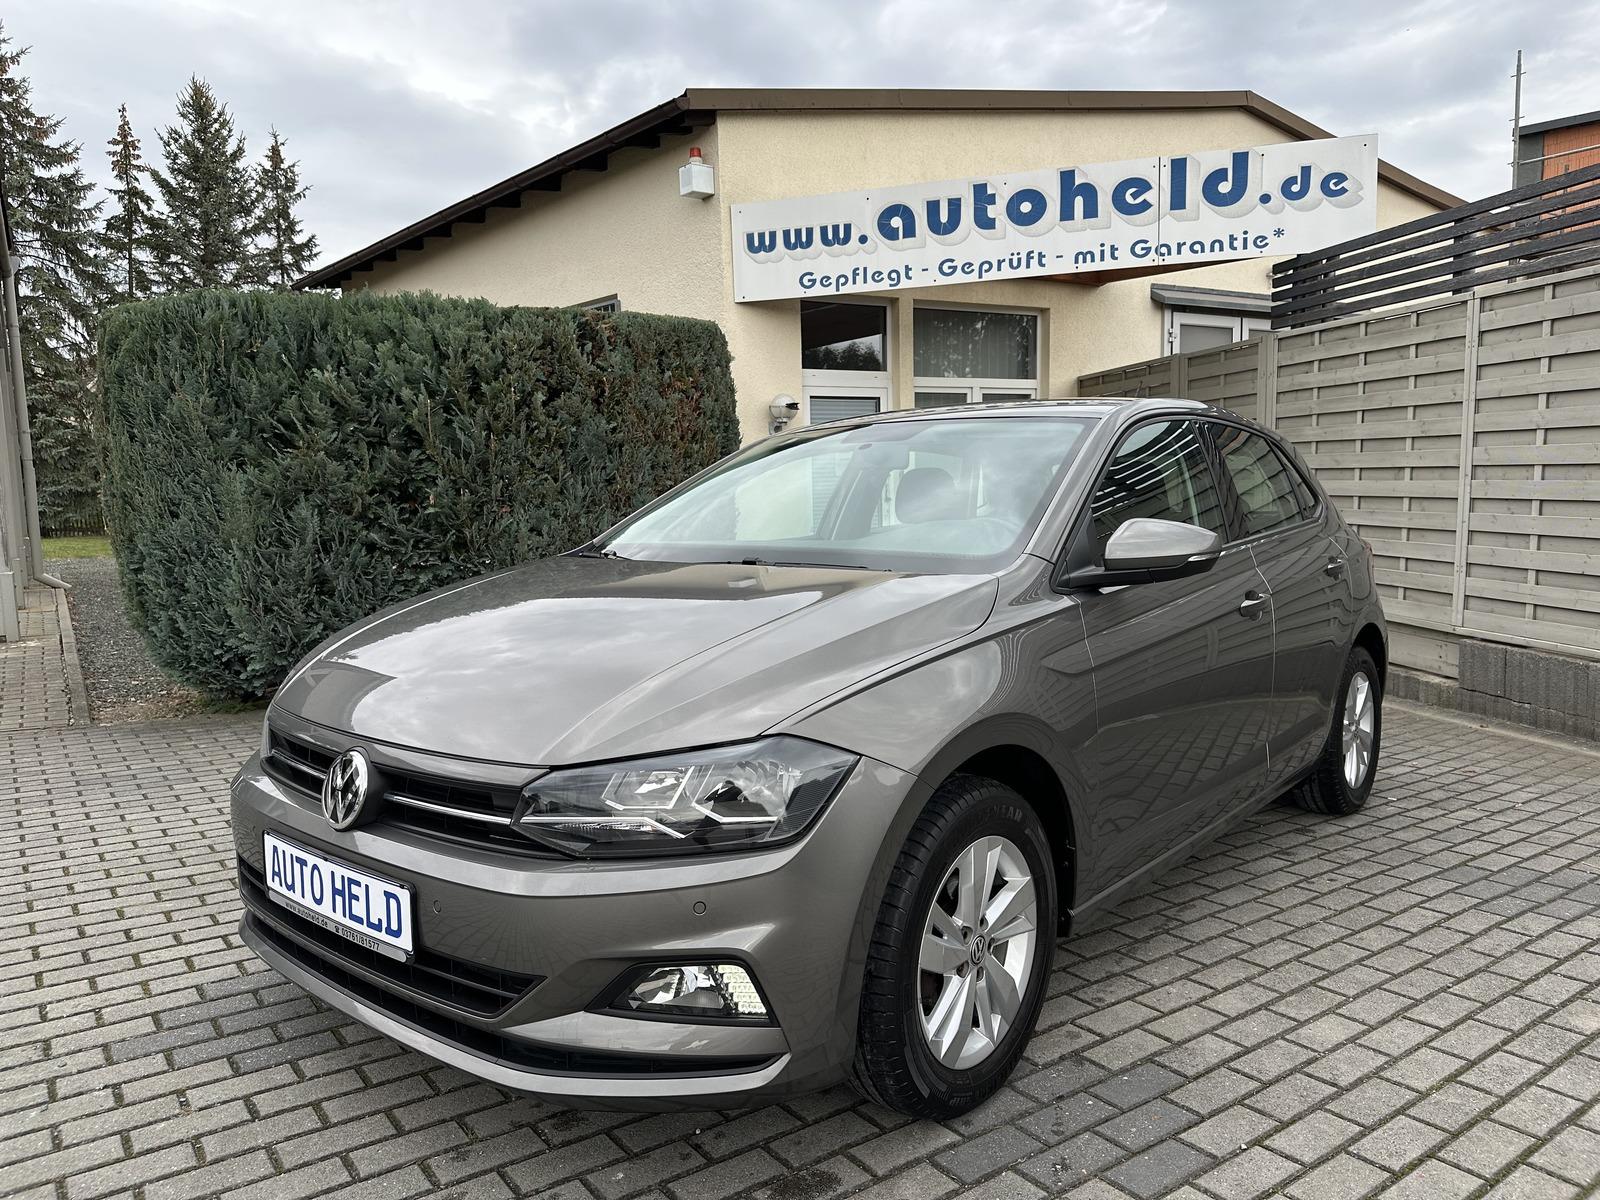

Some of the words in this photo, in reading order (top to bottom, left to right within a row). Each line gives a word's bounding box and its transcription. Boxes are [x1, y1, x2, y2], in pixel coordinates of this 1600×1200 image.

[746, 151, 1349, 254] www.autoheld.de
[799, 264, 913, 292] Gepflegt
[938, 249, 1046, 279] Geprüft
[1074, 243, 1119, 265] mit
[271, 844, 324, 906] AUTO
[330, 870, 403, 939] HELD
[341, 927, 380, 950] 03761/81577
